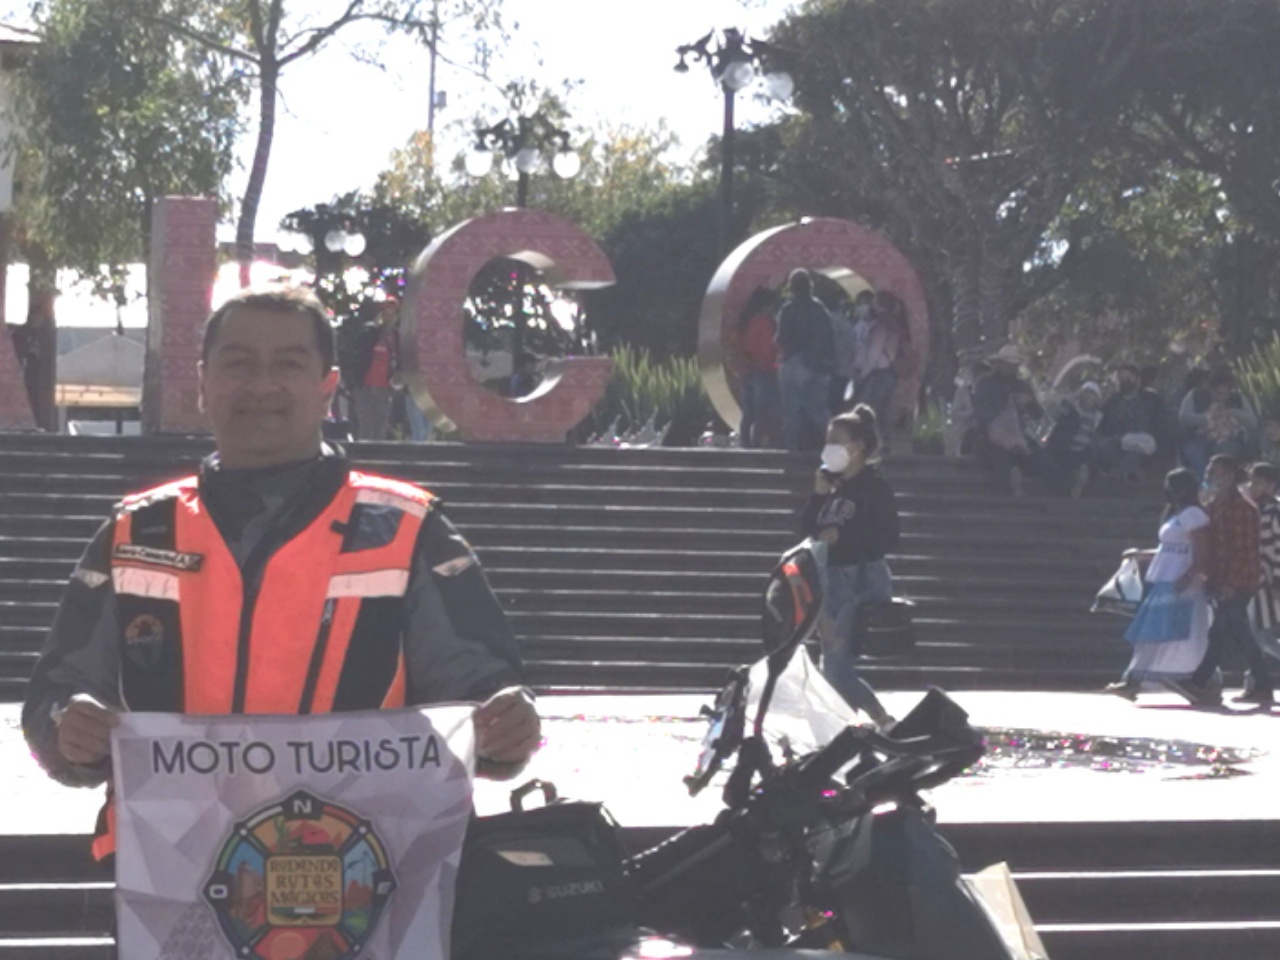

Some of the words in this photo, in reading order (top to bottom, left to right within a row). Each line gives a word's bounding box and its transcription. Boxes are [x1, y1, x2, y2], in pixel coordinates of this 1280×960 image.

[152, 740, 276, 774] MOTO
[286, 735, 441, 774] TURISTA
[293, 799, 313, 814] N
[546, 880, 605, 899] SUZUKI
